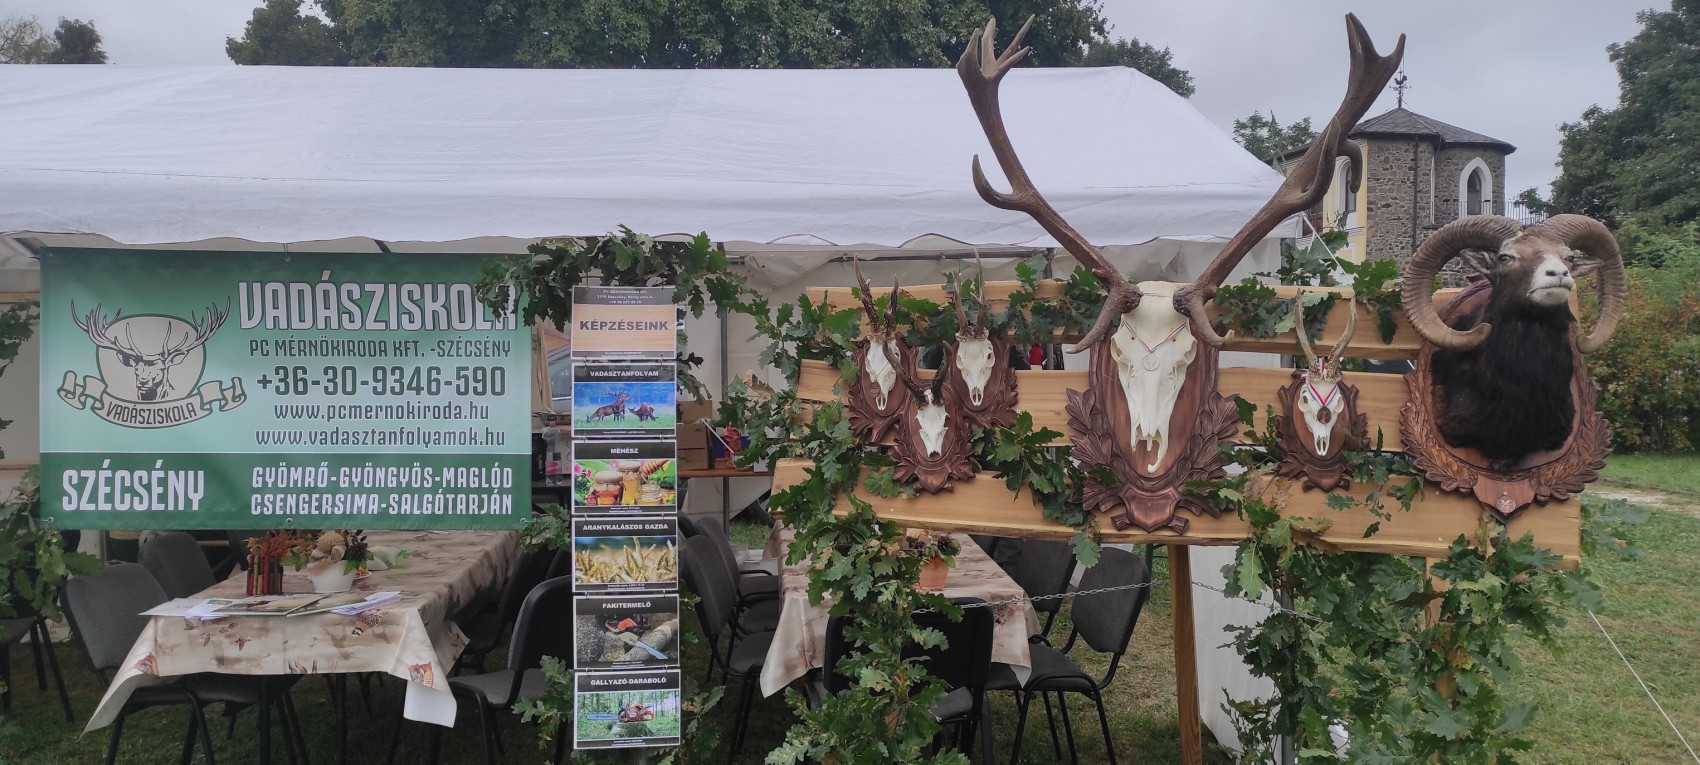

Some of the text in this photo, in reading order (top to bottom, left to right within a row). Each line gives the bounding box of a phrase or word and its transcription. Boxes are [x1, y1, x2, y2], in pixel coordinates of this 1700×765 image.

[238, 269, 517, 331] VADÁSZISKOLA
[580, 319, 669, 331] KÉPZÉSEINK
[249, 334, 511, 358] PC MÉRNÖKIRODA KFT. -SZÉCSÉNY
[256, 365, 506, 397] +36-30-9346-590
[590, 369, 659, 377] VADÁSZTANFOLYAM
[105, 400, 198, 425] VADÁSZISKOLA
[274, 400, 489, 423] www.pcmernokiroda.hu
[255, 426, 505, 449] www.vadasztanfolyamok.hu
[62, 458, 205, 511] SZÉCSÉNY
[252, 461, 513, 489] GYÖMRŐ-GYÖNGYÖS-MAGLÓD
[251, 488, 512, 515] CSENGERSIMA-SALGÓTARJÁN
[582, 523, 643, 531] ARANYKALÁSZOS
[590, 676, 667, 686] GALLYAZÓ-DARABOLÓ
